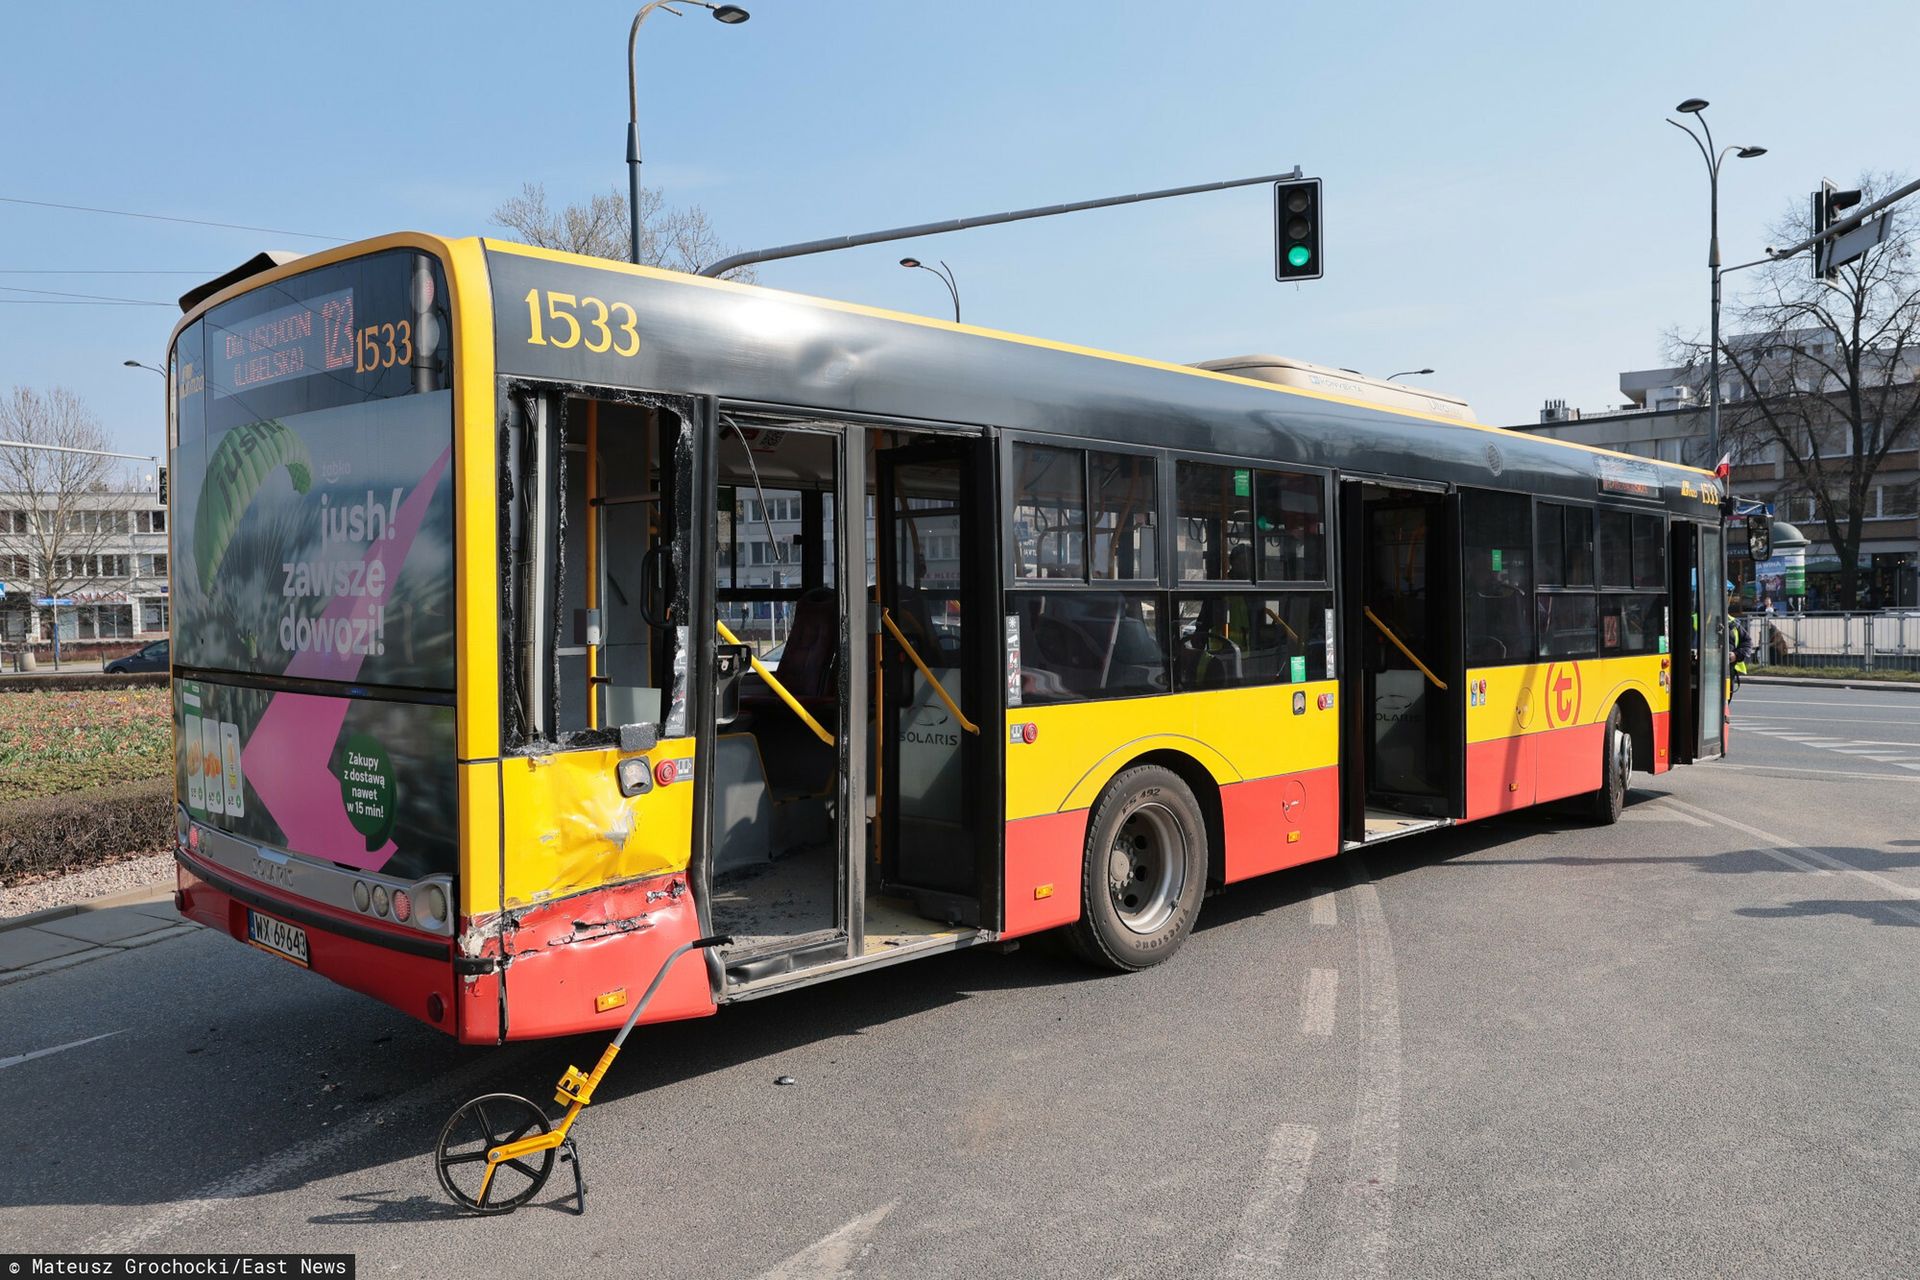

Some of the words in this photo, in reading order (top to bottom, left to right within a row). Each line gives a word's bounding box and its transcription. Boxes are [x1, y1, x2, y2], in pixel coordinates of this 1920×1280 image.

[525, 288, 640, 357] 1533
[355, 319, 413, 374] 1533
[1701, 482, 1719, 506] 1533
[321, 487, 403, 550] jush!
[282, 559, 386, 598] zawsze
[279, 603, 385, 656] dowozi!
[344, 770, 349, 780] z
[349, 768, 385, 789] dostawą
[348, 752, 379, 771] Zakupy
[346, 802, 354, 813] w
[355, 801, 364, 815] 15
[365, 804, 384, 818] min!
[351, 787, 378, 801] nawet
[254, 914, 270, 943] WX
[273, 922, 306, 957] 69643
